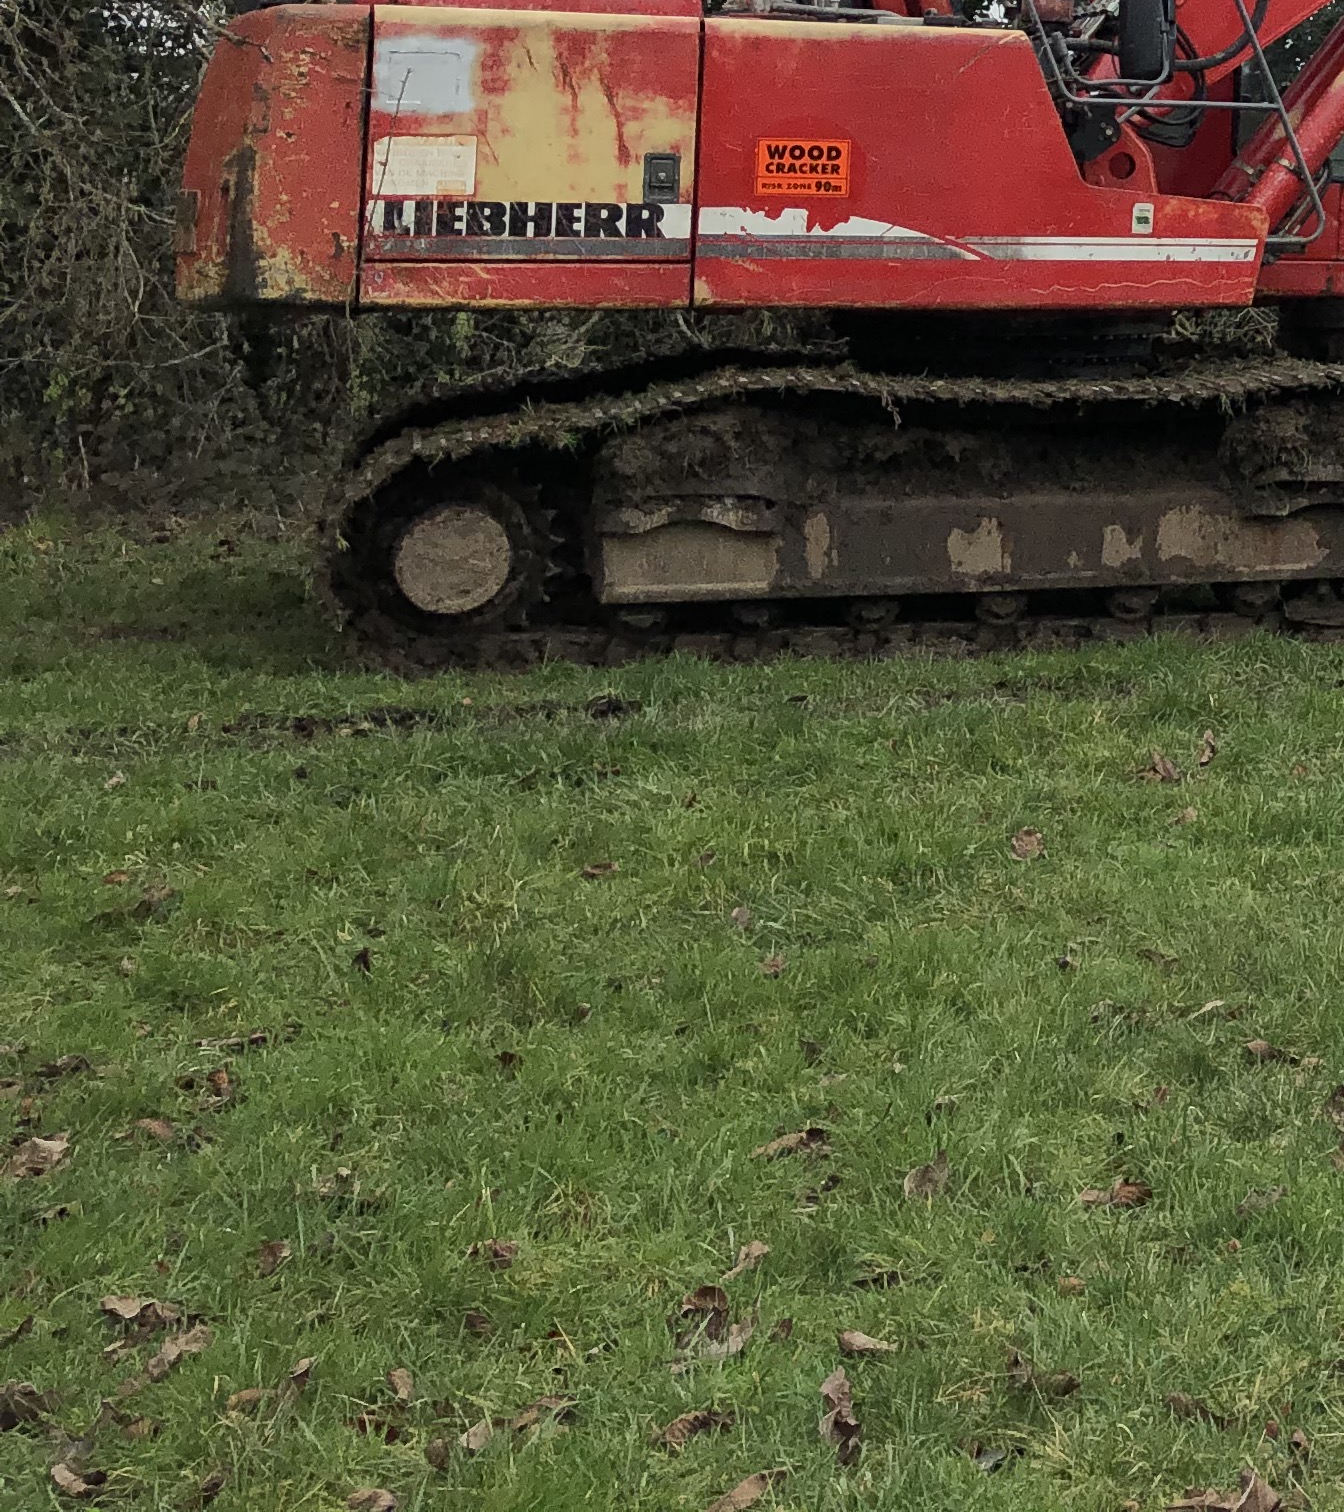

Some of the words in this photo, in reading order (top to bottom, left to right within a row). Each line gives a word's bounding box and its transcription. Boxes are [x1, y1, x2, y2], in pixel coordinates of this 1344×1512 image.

[766, 144, 842, 162] WOOD
[765, 162, 841, 175] CRACKER
[383, 201, 667, 238] LIEBHERR
